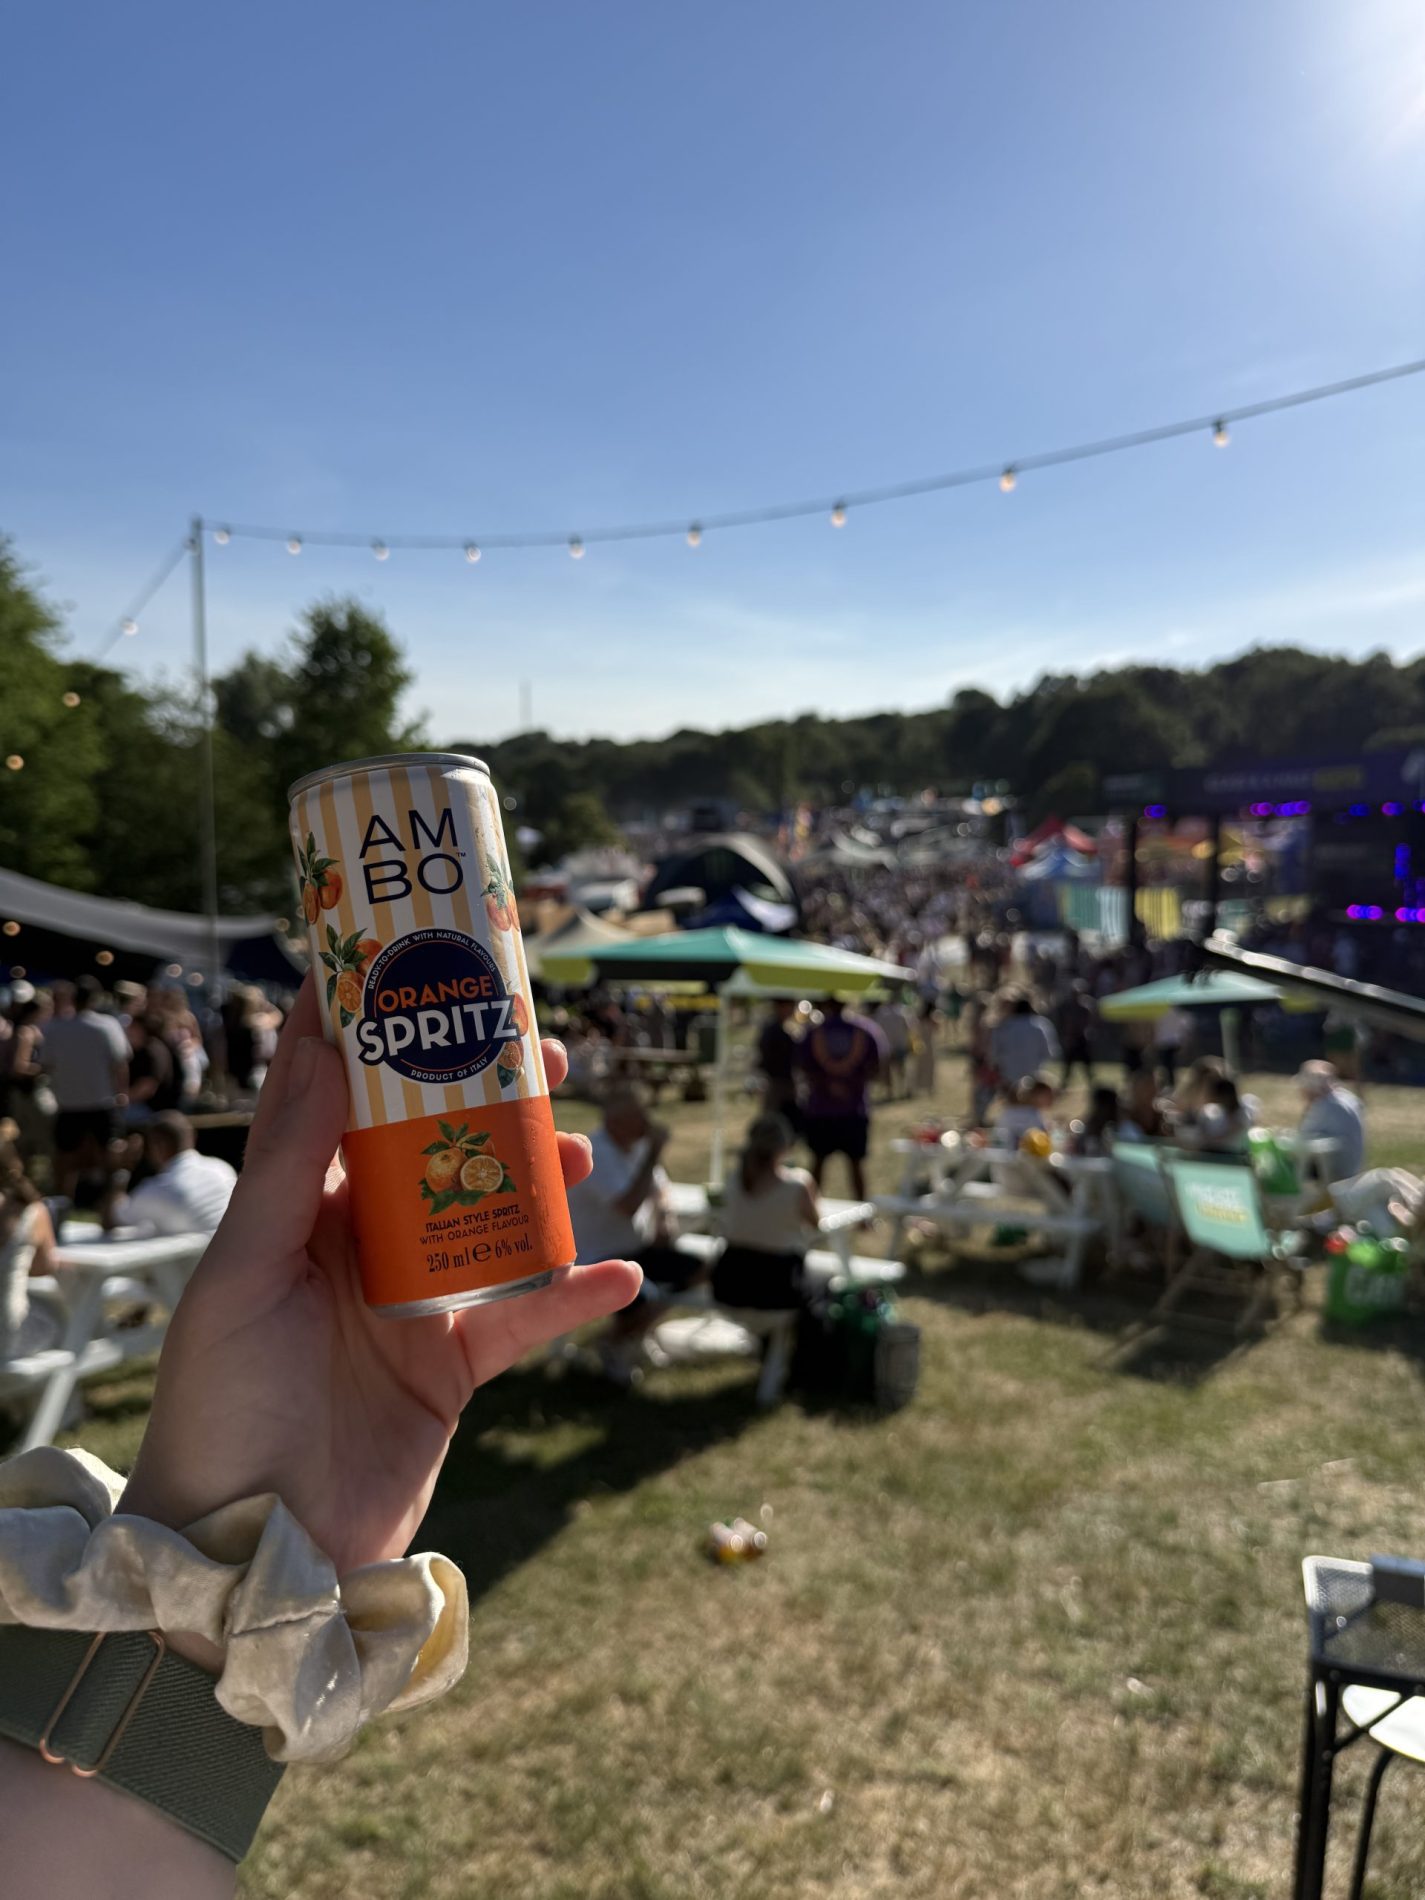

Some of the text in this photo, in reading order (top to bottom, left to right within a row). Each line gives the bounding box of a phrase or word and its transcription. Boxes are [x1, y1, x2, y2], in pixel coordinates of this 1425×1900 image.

[359, 808, 458, 859] AM
[368, 931, 496, 989] READY-TO-DRINK WITH NATURAL FLAVOURS
[378, 975, 493, 1013] ORANGE
[359, 999, 518, 1062] SPRITZ
[411, 1056, 489, 1081] PRODUCT OF ITALY
[420, 1215, 529, 1245] WITH ORANGE FLAVOUR
[425, 1204, 520, 1233] ITALIAN STYLE SPRITZ
[427, 1251, 449, 1273] 250
[453, 1247, 470, 1268] ml
[495, 1239, 512, 1258] 6%
[514, 1233, 533, 1252] vol.
